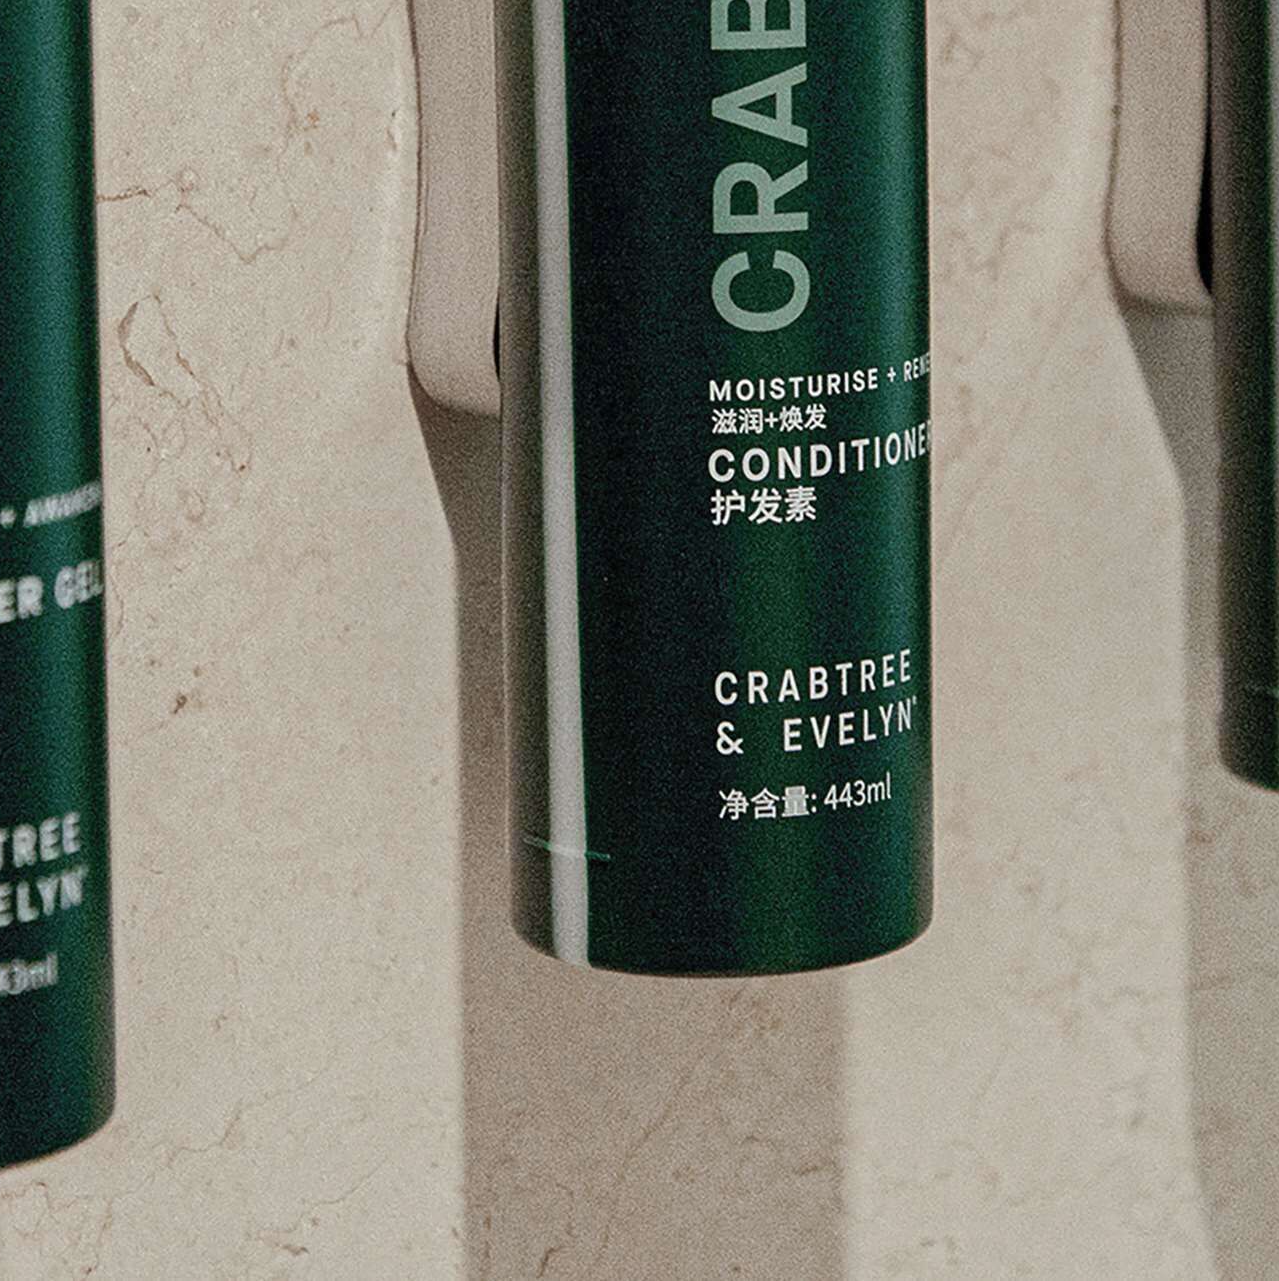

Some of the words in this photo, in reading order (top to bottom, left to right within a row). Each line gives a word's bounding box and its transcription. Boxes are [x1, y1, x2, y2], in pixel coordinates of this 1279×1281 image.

[708, 367, 879, 402] MOISTURISE
[903, 352, 929, 382] RENE
[711, 404, 828, 435] 滋润+焕发
[710, 485, 817, 525] 护发素
[714, 648, 912, 706] CRABTREE
[715, 720, 745, 756] &
[783, 698, 912, 753] EVELYN
[823, 771, 893, 812] 443ml
